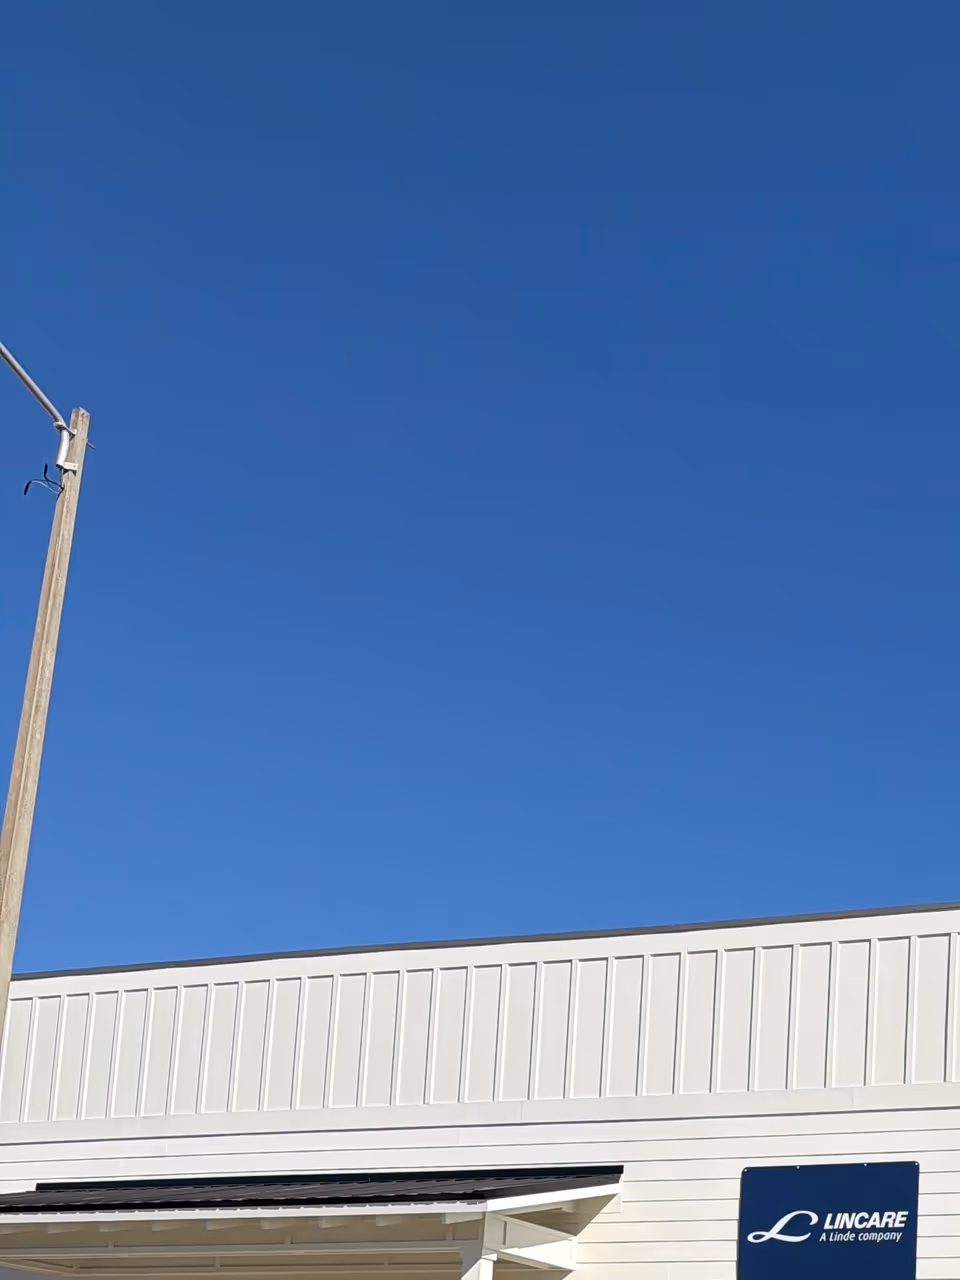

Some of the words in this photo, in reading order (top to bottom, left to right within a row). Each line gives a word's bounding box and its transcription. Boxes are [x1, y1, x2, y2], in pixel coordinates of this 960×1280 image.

[823, 1211, 909, 1230] LINCARE
[819, 1232, 827, 1242] A
[829, 1231, 855, 1242] Linde
[858, 1231, 903, 1243] company
